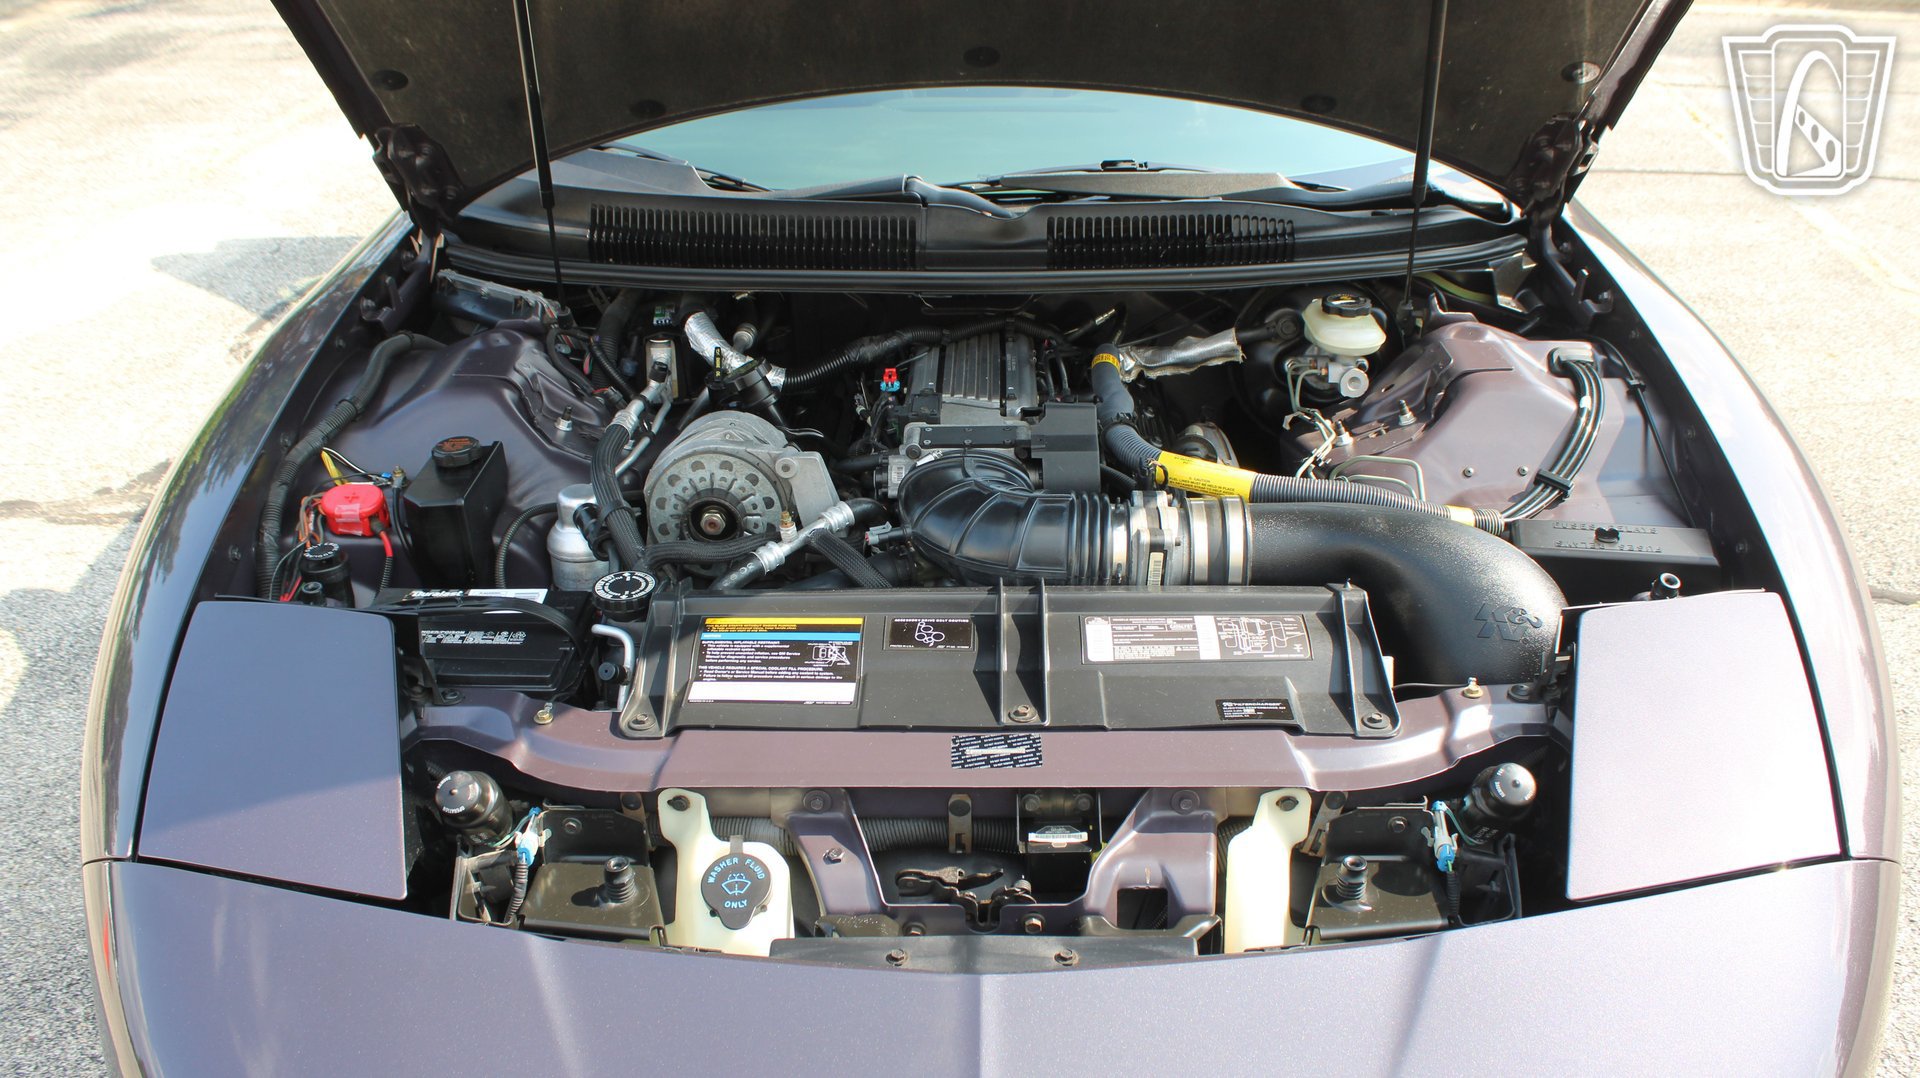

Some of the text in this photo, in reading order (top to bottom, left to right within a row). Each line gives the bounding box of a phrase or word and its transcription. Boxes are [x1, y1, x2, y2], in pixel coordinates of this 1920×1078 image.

[707, 857, 766, 883] WASHER FLUID
[724, 899, 748, 909] ONLY
